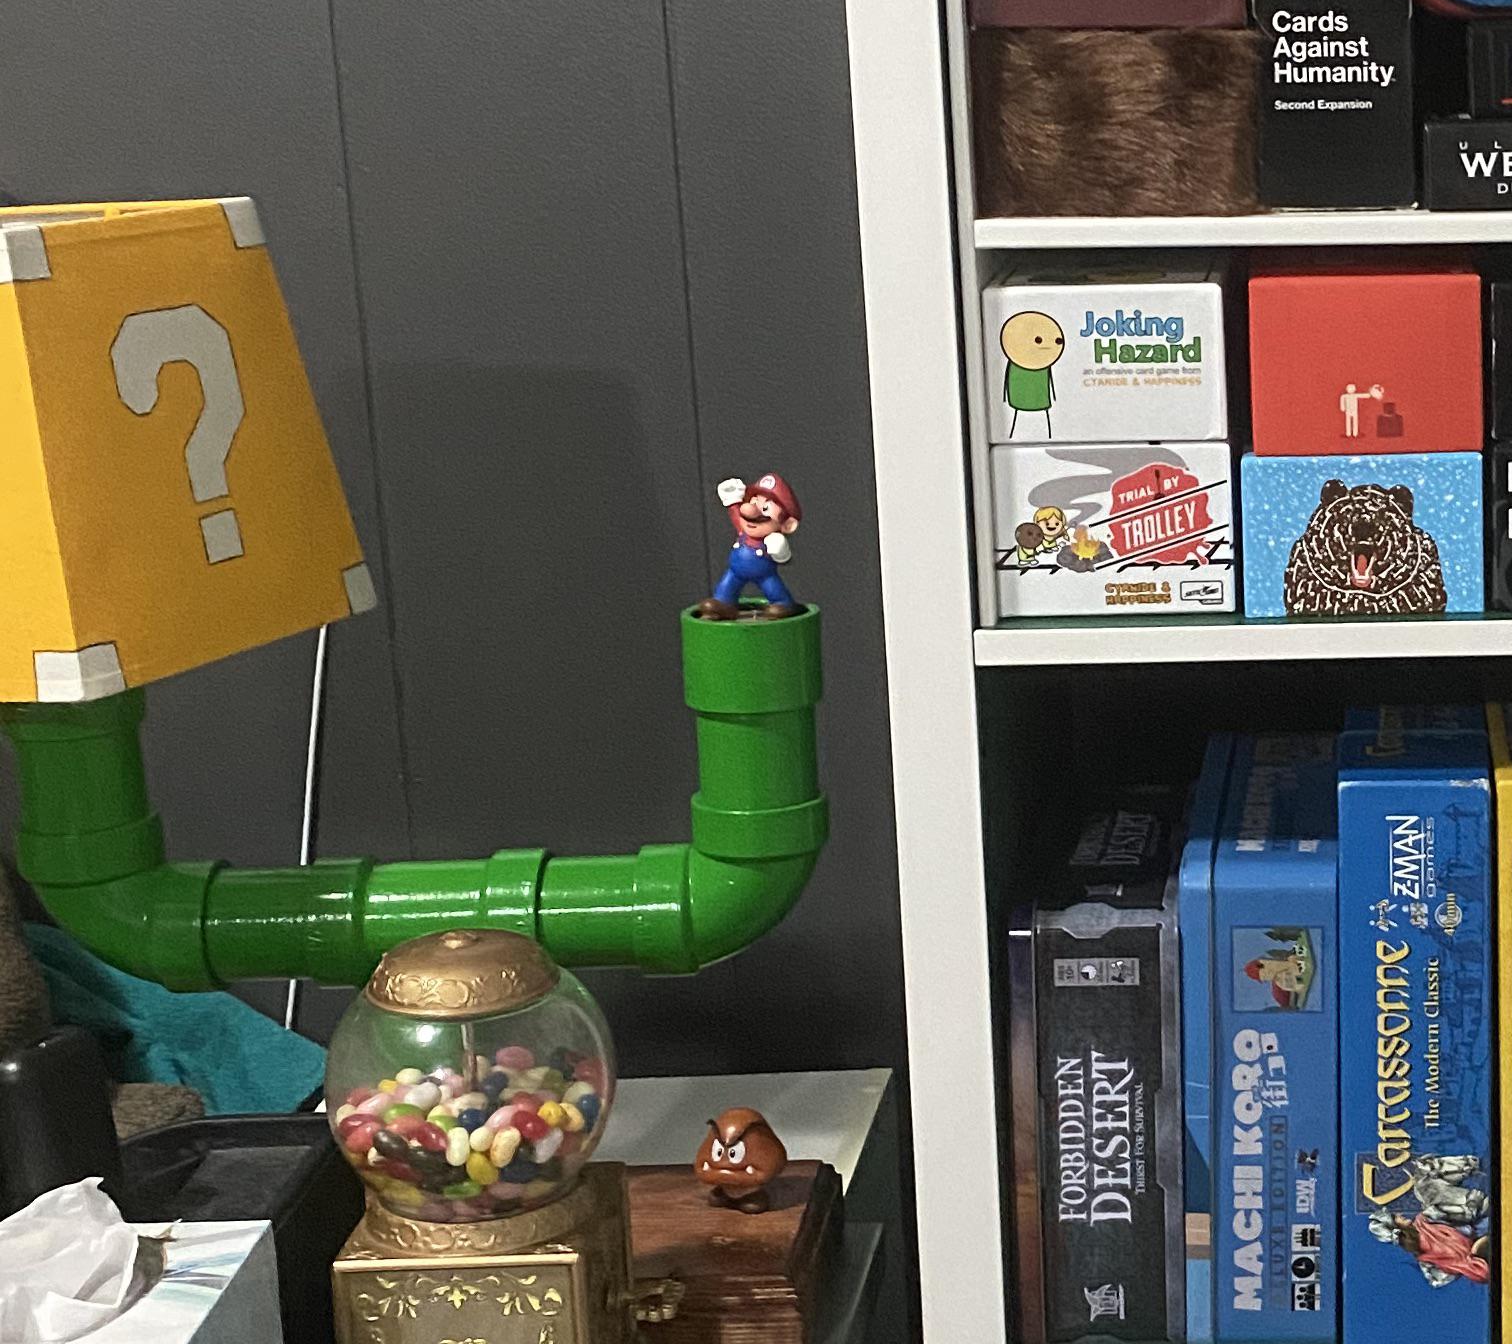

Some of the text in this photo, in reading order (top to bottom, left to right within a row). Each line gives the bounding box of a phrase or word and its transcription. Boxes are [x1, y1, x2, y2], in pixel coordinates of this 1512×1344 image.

[1272, 10, 1349, 33] Cards
[1273, 36, 1370, 63] Against
[1274, 61, 1395, 87] Humanity
[1274, 99, 1373, 112] Second Expansion
[1080, 309, 1185, 344] Joking
[1094, 336, 1202, 364] Hazard
[1119, 476, 1180, 504] TRIAL BY
[1121, 500, 1196, 550] TROLLEY
[1385, 815, 1426, 900] Z-MAN
[1426, 816, 1437, 898] games
[1422, 958, 1440, 1130] The Modern Classic
[1363, 940, 1417, 1206] Carcassonne
[1054, 1056, 1088, 1224] FORBIDDEN
[1090, 1050, 1134, 1228] DESERT
[1231, 1028, 1265, 1312] MACHI KORO
